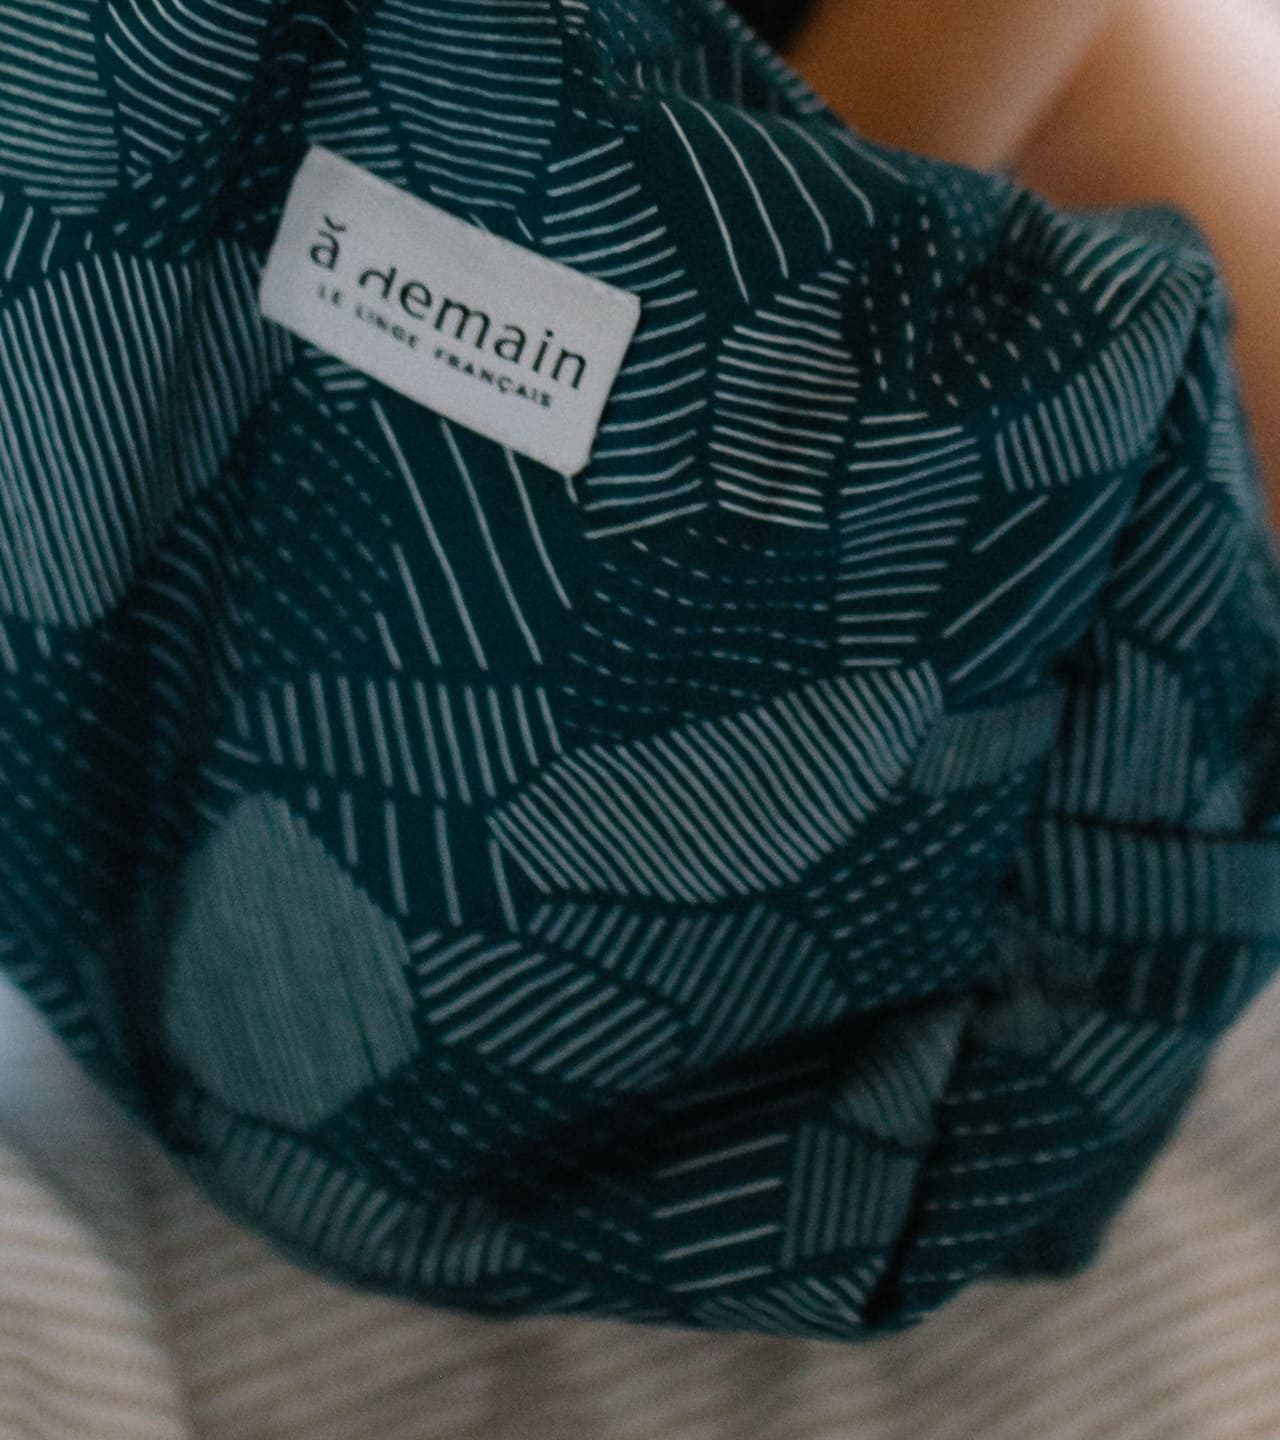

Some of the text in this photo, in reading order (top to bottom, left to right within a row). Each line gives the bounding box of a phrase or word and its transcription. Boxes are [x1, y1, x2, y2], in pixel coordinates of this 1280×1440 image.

[319, 285, 552, 408] LE LINGE FRANÇAIS
[358, 266, 588, 390] demain
